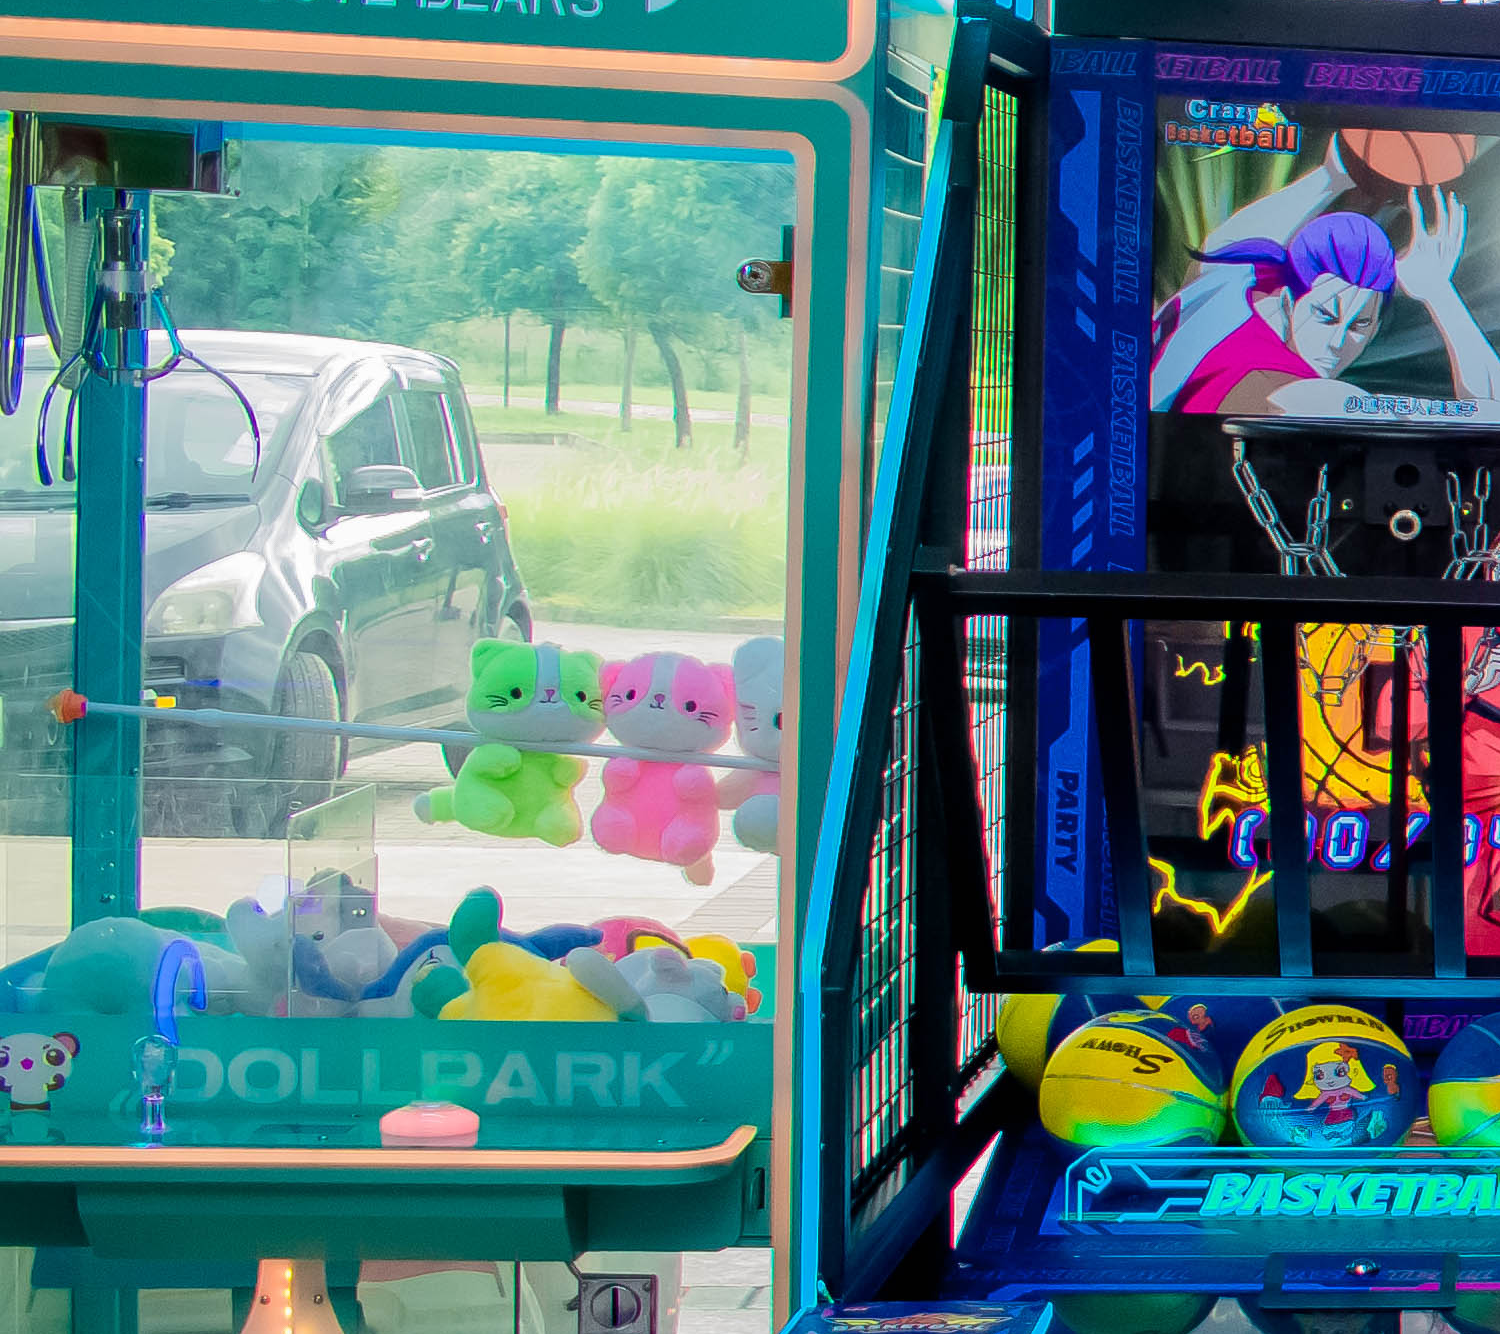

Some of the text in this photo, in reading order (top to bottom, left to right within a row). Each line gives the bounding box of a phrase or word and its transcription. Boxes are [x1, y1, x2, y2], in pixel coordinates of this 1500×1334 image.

[1114, 97, 1145, 305] BASKETBALL
[1109, 329, 1140, 538] BASKETBALL
[1048, 771, 1081, 875] PARTY
[1262, 1014, 1385, 1053] SHOWMAN
